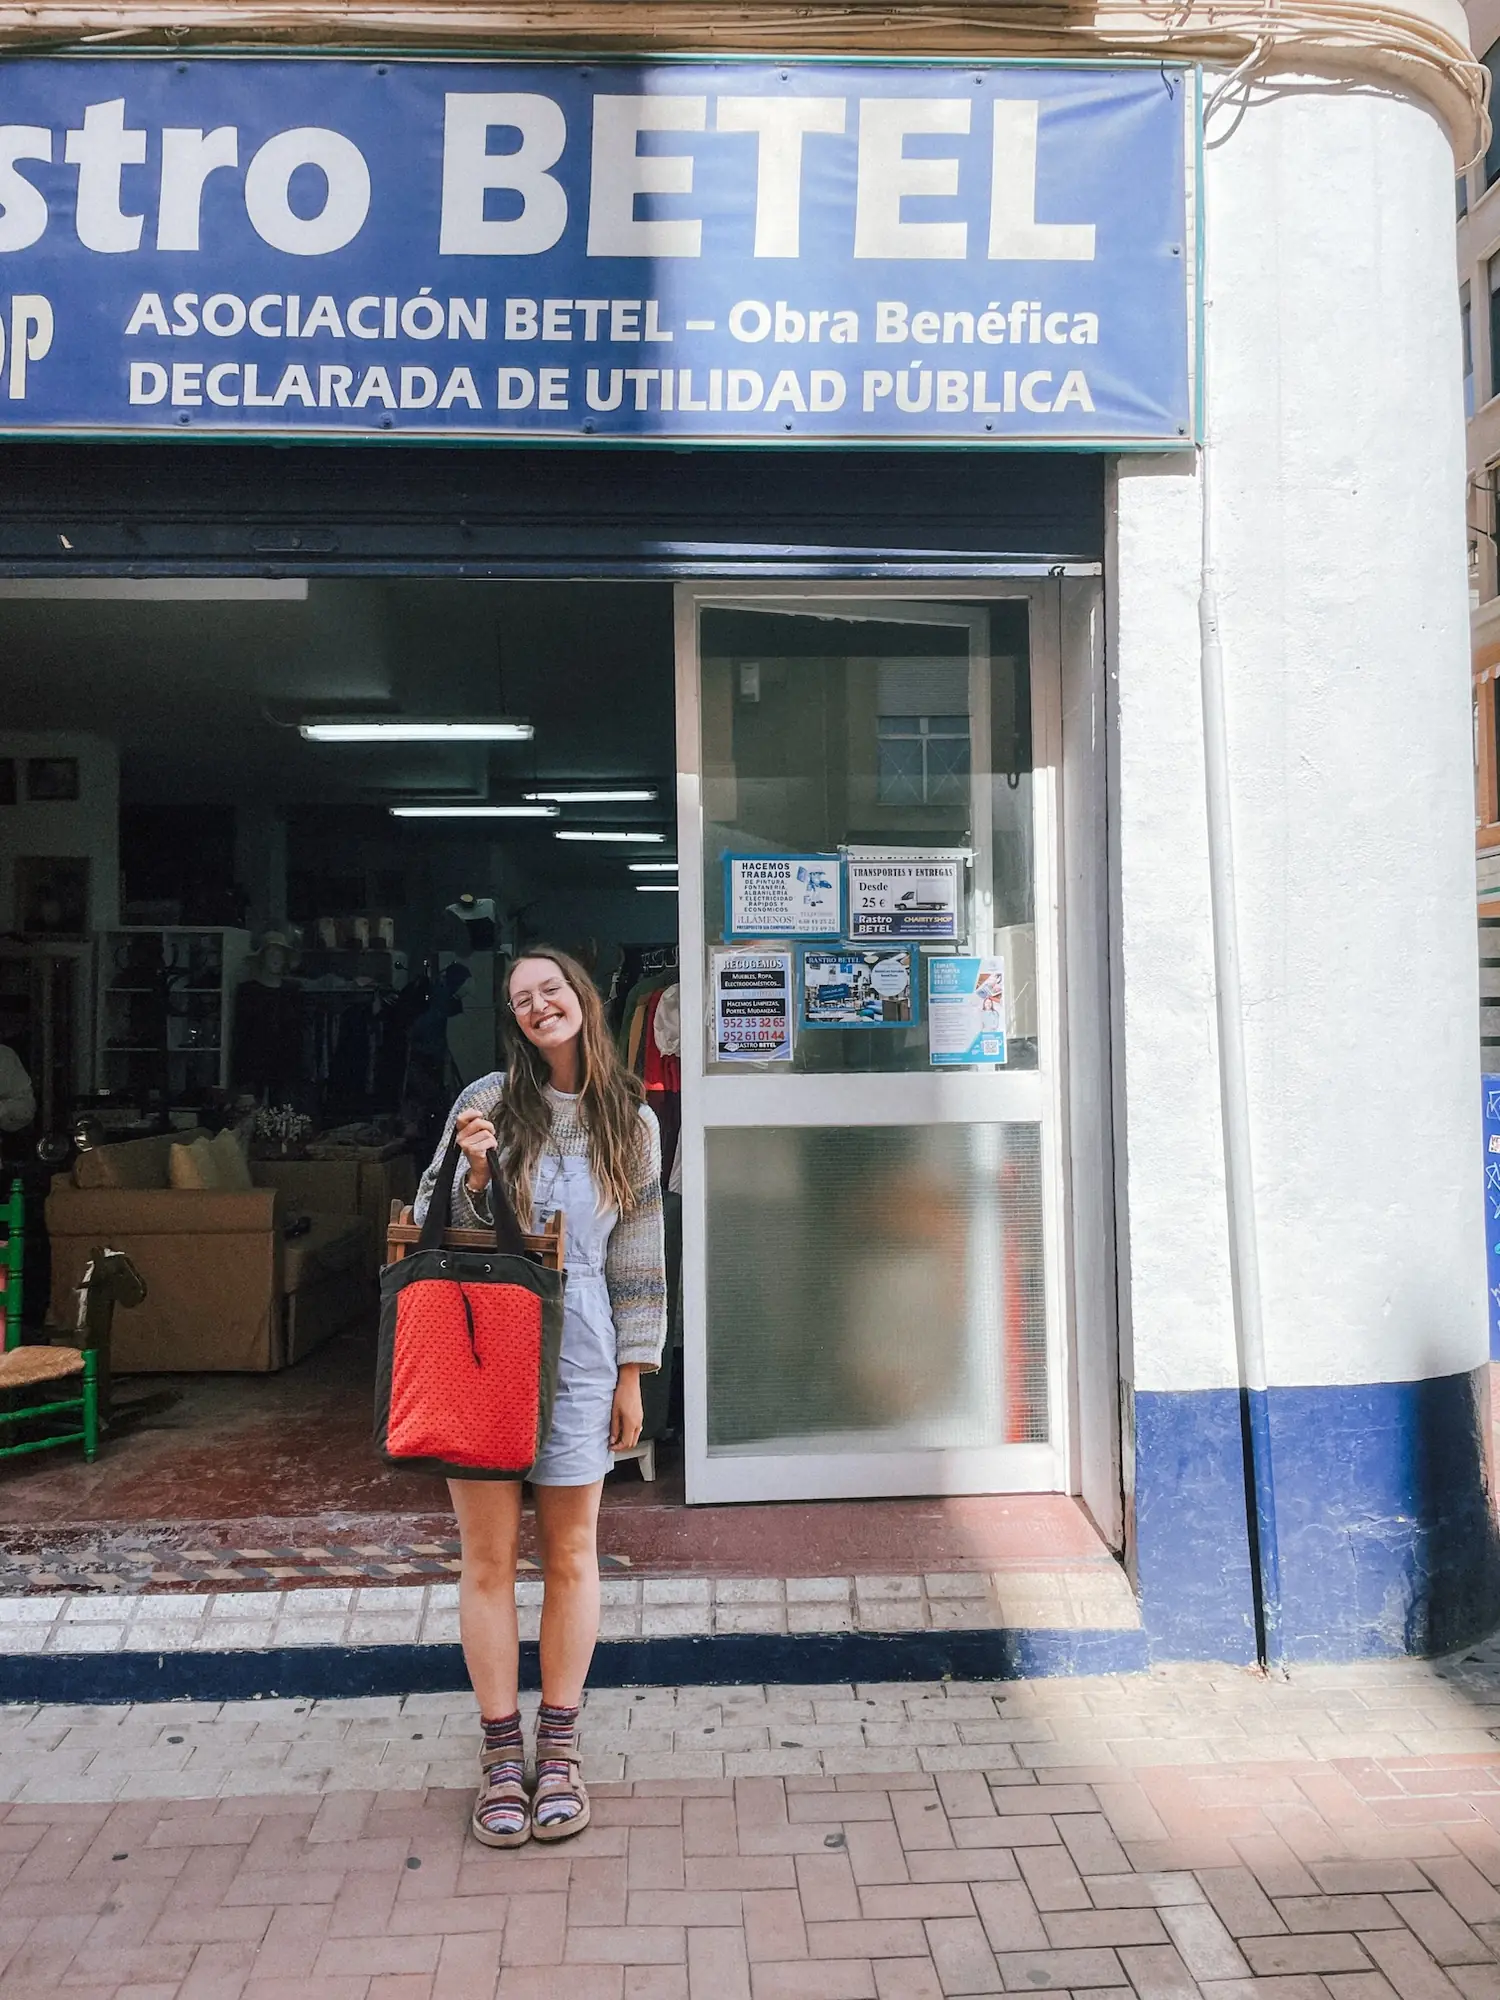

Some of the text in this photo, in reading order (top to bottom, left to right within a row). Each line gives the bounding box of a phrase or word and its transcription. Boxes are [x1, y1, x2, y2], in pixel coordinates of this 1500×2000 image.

[439, 92, 1096, 261] BETEL
[125, 288, 487, 341] ASOCIACIÓN
[505, 299, 673, 342] BETEL
[729, 301, 859, 344] Obra
[876, 301, 1099, 345] Benéfica
[129, 360, 1095, 413] DECLARADA DE UTILIDAD PÚBLICA
[742, 862, 790, 870] HACEMOS
[741, 871, 791, 879] TRABAJOS
[853, 868, 953, 876] TRANSPORTES Y ENTREGAS
[859, 882, 888, 891] Desde
[862, 897, 886, 908] 25 €
[859, 915, 893, 923] Rastro
[859, 924, 893, 933] BETEL
[723, 959, 784, 970] RECOGEMOS
[723, 1017, 785, 1028] 952 35 32 65
[723, 1030, 785, 1041] 952 61 01 44
